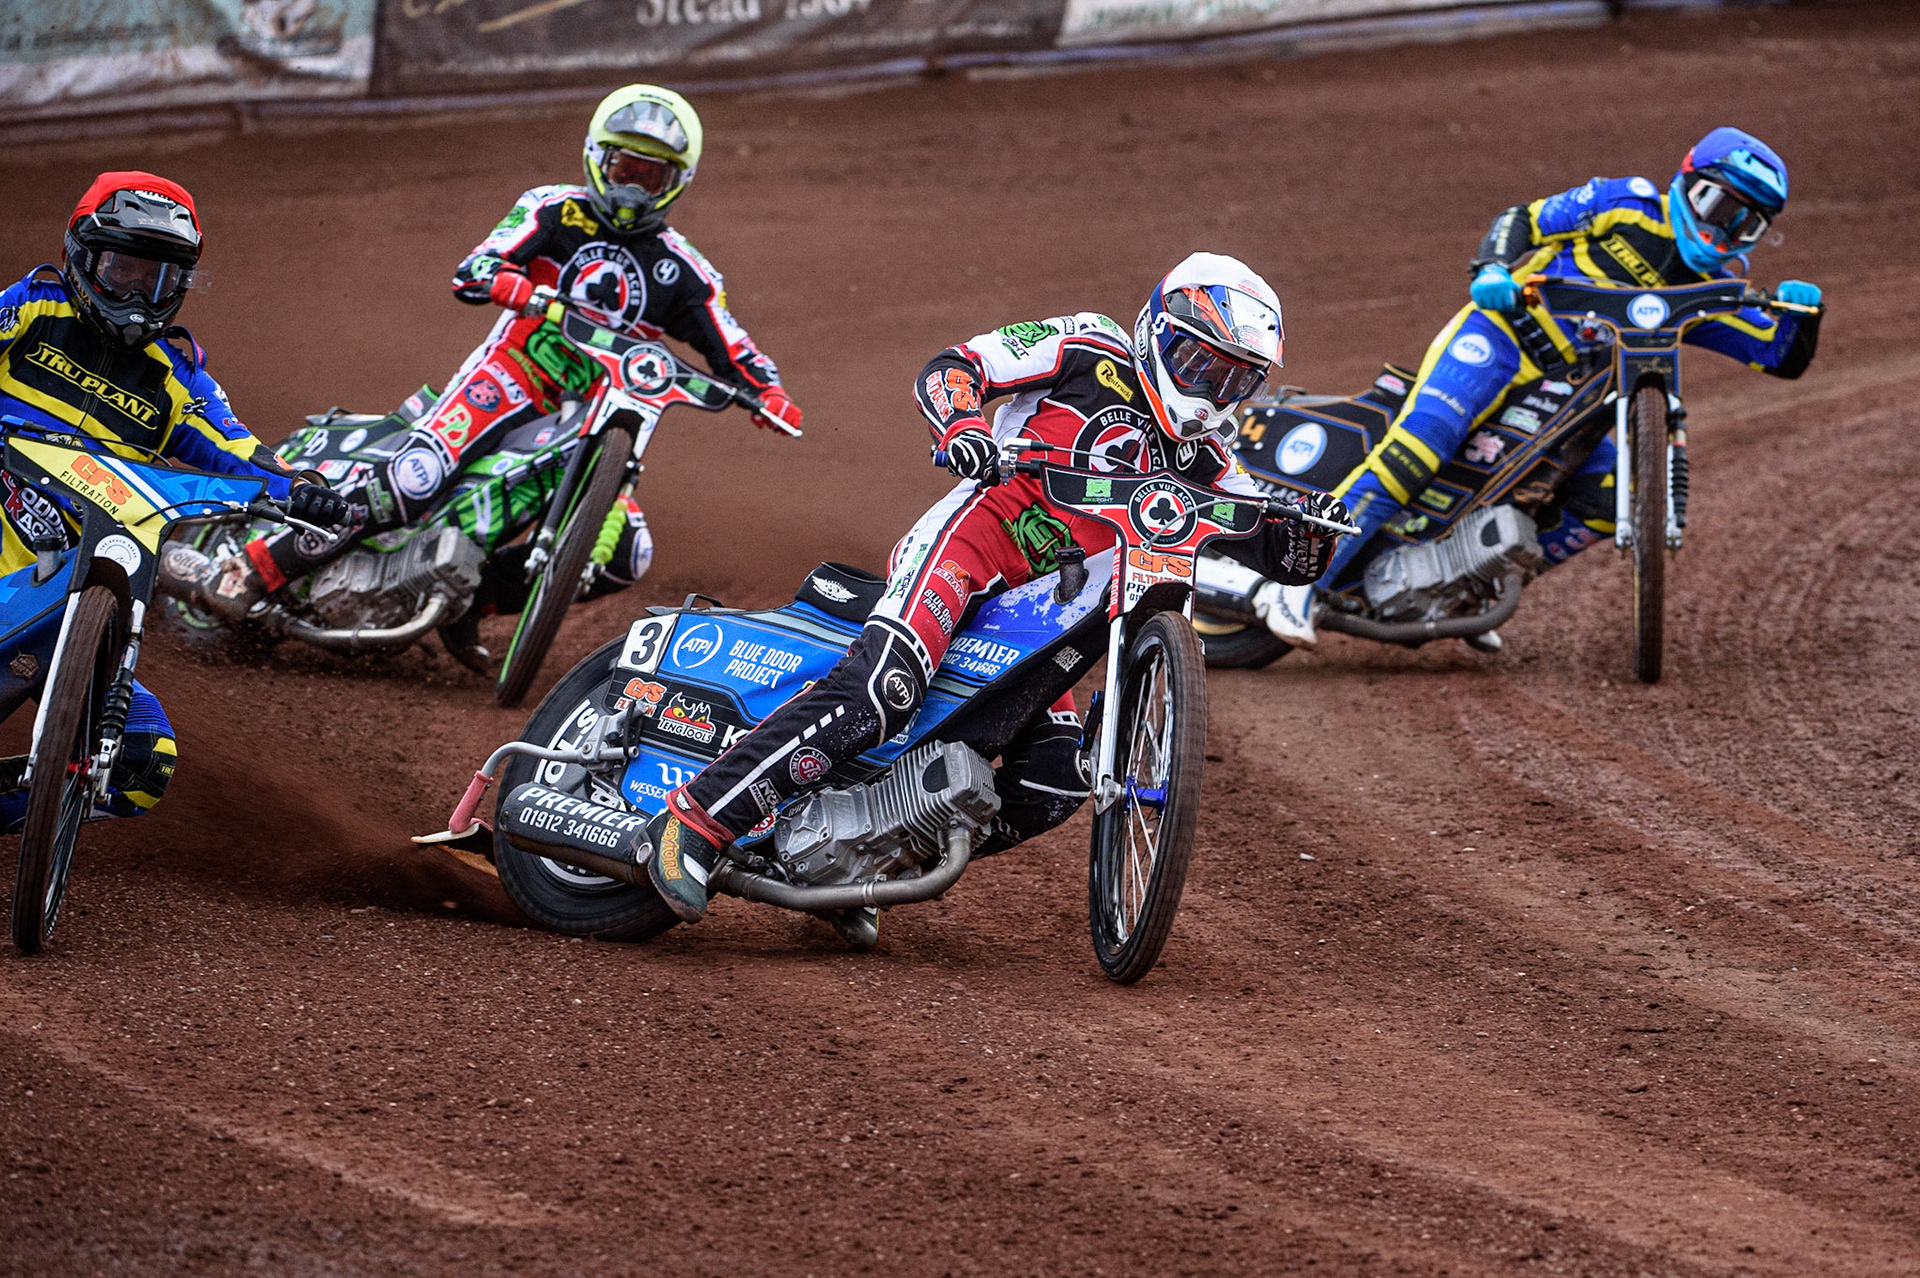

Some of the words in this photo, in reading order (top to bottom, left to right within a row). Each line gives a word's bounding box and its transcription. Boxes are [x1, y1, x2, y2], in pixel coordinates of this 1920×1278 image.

[1100, 367, 1132, 400] Rentruck
[1100, 411, 1132, 427] BELLE
[1150, 448, 1161, 472] ACE
[1241, 415, 1266, 442] 4
[70, 454, 133, 506] CFS
[407, 458, 430, 487] ATPI
[60, 470, 119, 516] FILTRATION
[1134, 484, 1156, 504] BELLE
[1159, 483, 1177, 493] VUE
[1129, 549, 1192, 577] CFS
[923, 588, 945, 609] BLUE
[922, 598, 951, 635] PROJECT
[630, 621, 663, 665] 3
[680, 637, 714, 655] ATPI
[729, 639, 763, 663] BLUE
[763, 646, 803, 674] DOOR
[723, 658, 785, 690] PROJECT
[890, 674, 911, 704] ATPI
[623, 678, 667, 703] CFS
[518, 786, 647, 832] PREMIER
[519, 807, 562, 834] 01912
[563, 821, 621, 849] 341666
